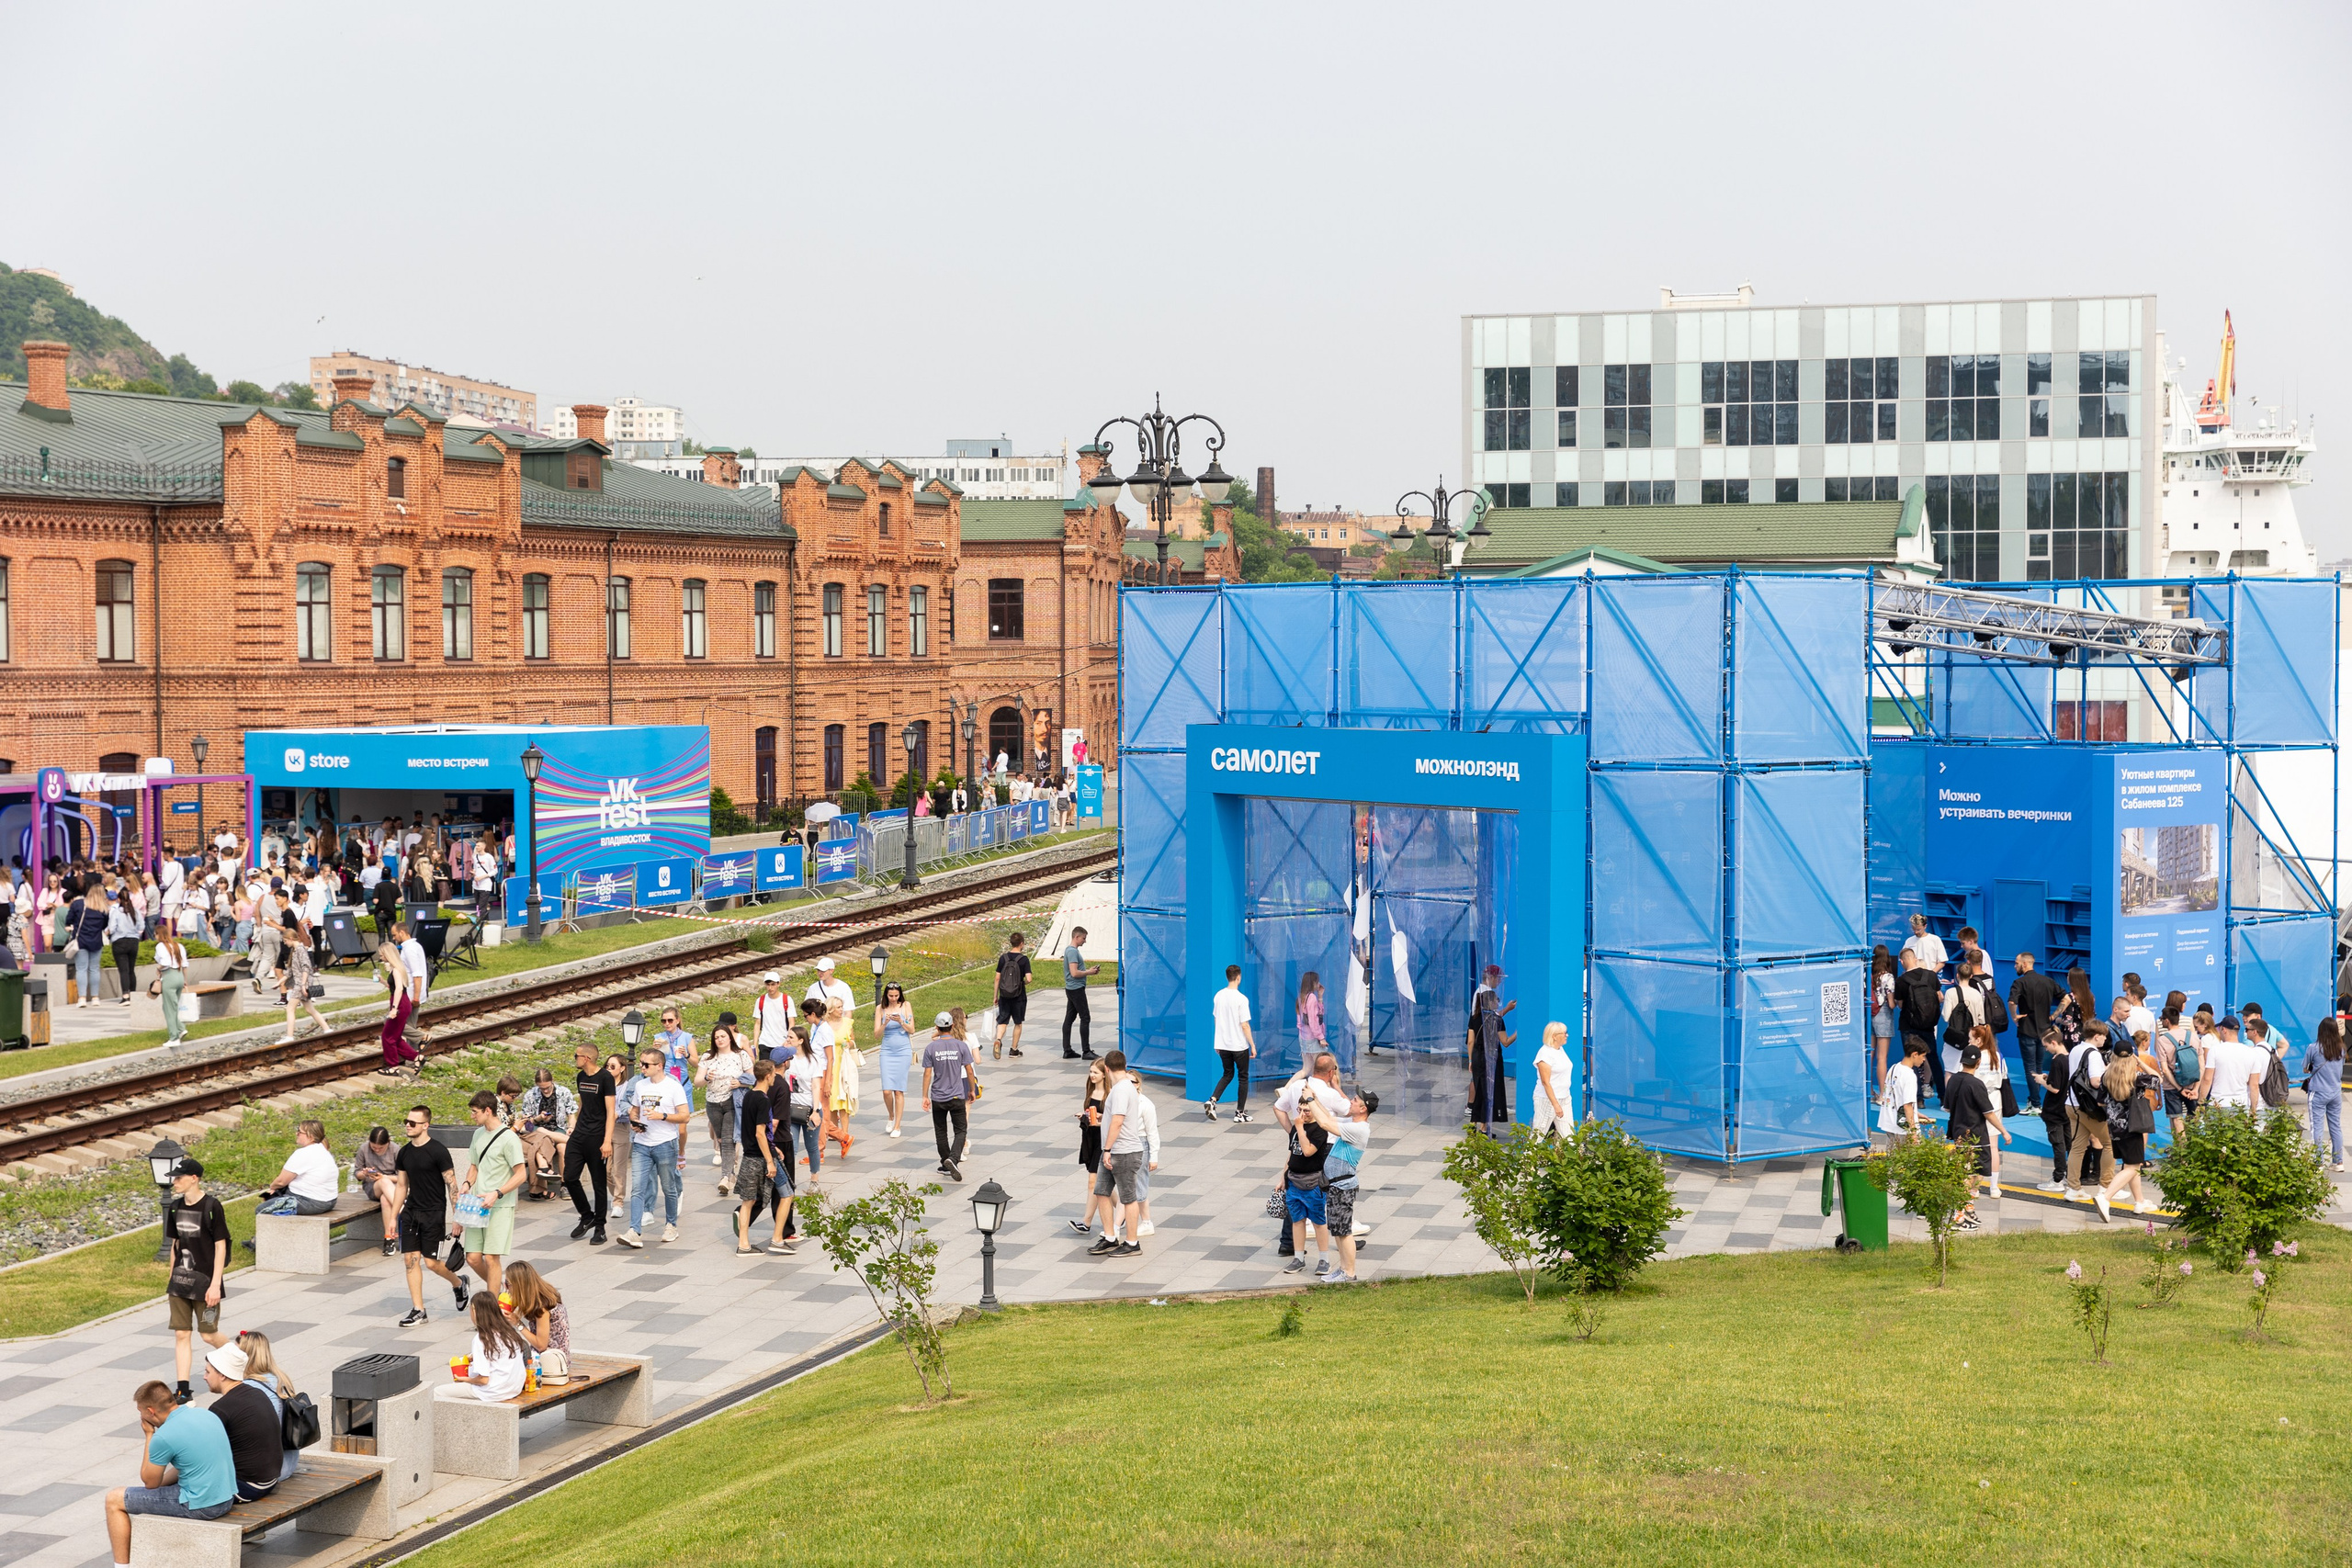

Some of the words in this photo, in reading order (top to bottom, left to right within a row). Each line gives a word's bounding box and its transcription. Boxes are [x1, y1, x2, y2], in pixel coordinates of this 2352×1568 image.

[309, 752, 350, 769] store
[407, 758, 442, 768] место
[443, 758, 489, 770] встречи
[1211, 747, 1320, 775] самолет
[1415, 758, 1521, 782] можнолэнд
[2120, 769, 2154, 780] Уютные
[2155, 769, 2196, 781] квартиры
[607, 778, 639, 802] VK
[1939, 788, 1981, 802] Можно
[2120, 785, 2127, 795] в
[2128, 784, 2156, 795] жилом
[2157, 783, 2202, 794] комплексе
[2120, 797, 2166, 809] Сабанеева
[2167, 796, 2184, 807] 125
[599, 795, 651, 829] fest
[1939, 807, 2006, 820] устраивать
[2007, 809, 2072, 823] вечеринки
[600, 833, 651, 847] ВЛАДИВОСТОК
[600, 873, 613, 884] VK
[595, 881, 616, 896] fest
